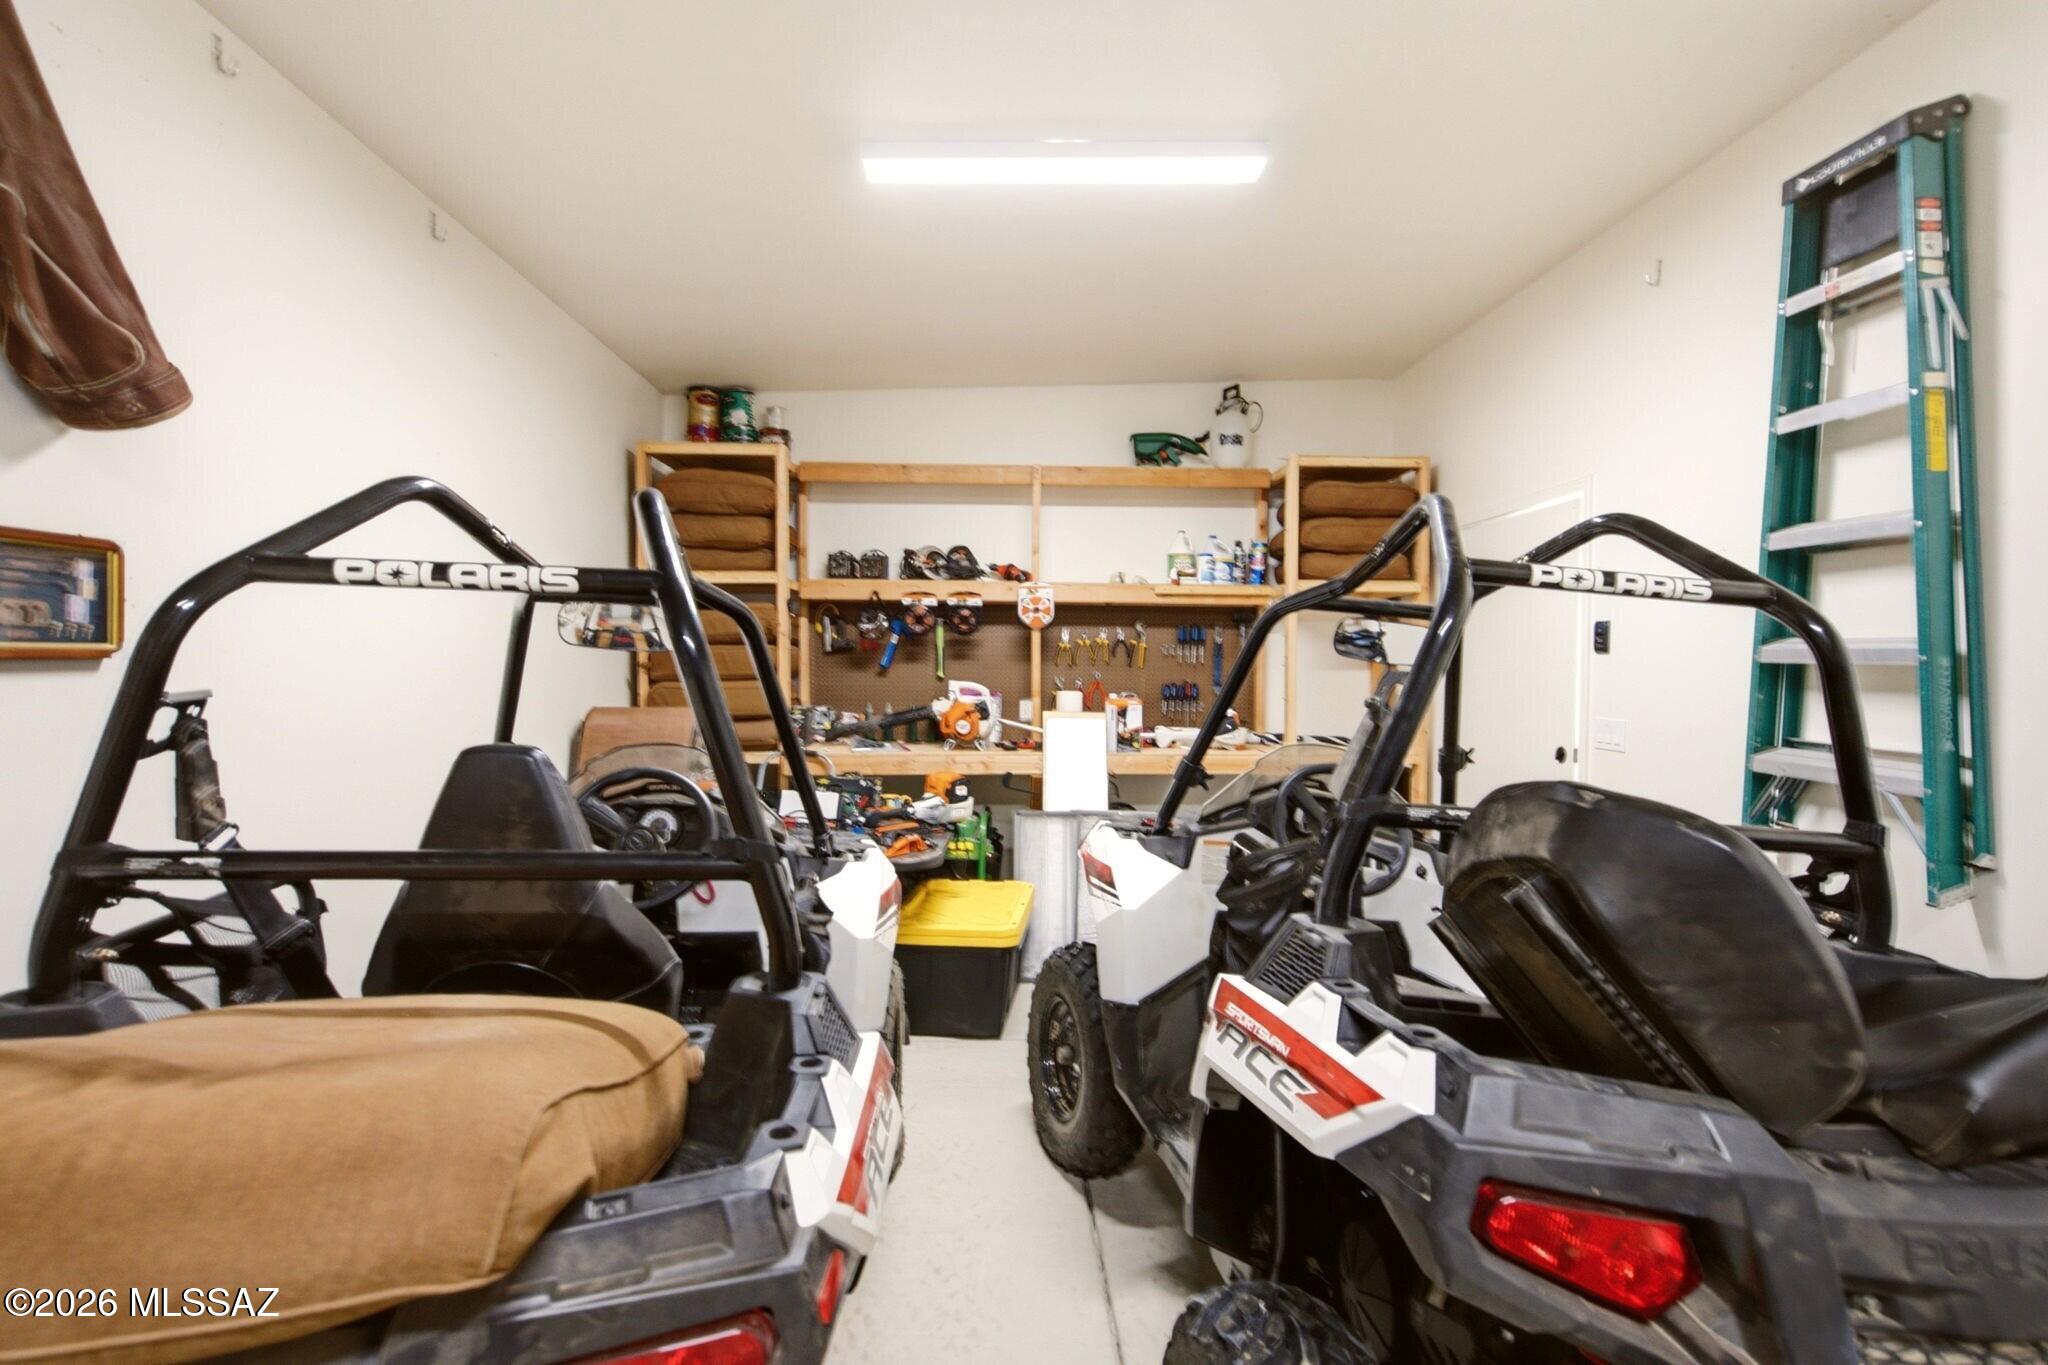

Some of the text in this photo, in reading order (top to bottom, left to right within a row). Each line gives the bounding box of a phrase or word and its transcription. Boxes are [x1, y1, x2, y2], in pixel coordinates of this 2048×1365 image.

[333, 558, 580, 594] POLARIS
[1530, 564, 1713, 601] POLARIS
[1224, 1002, 1290, 1057] SPORTSMAN
[1217, 1022, 1309, 1113] ACE
